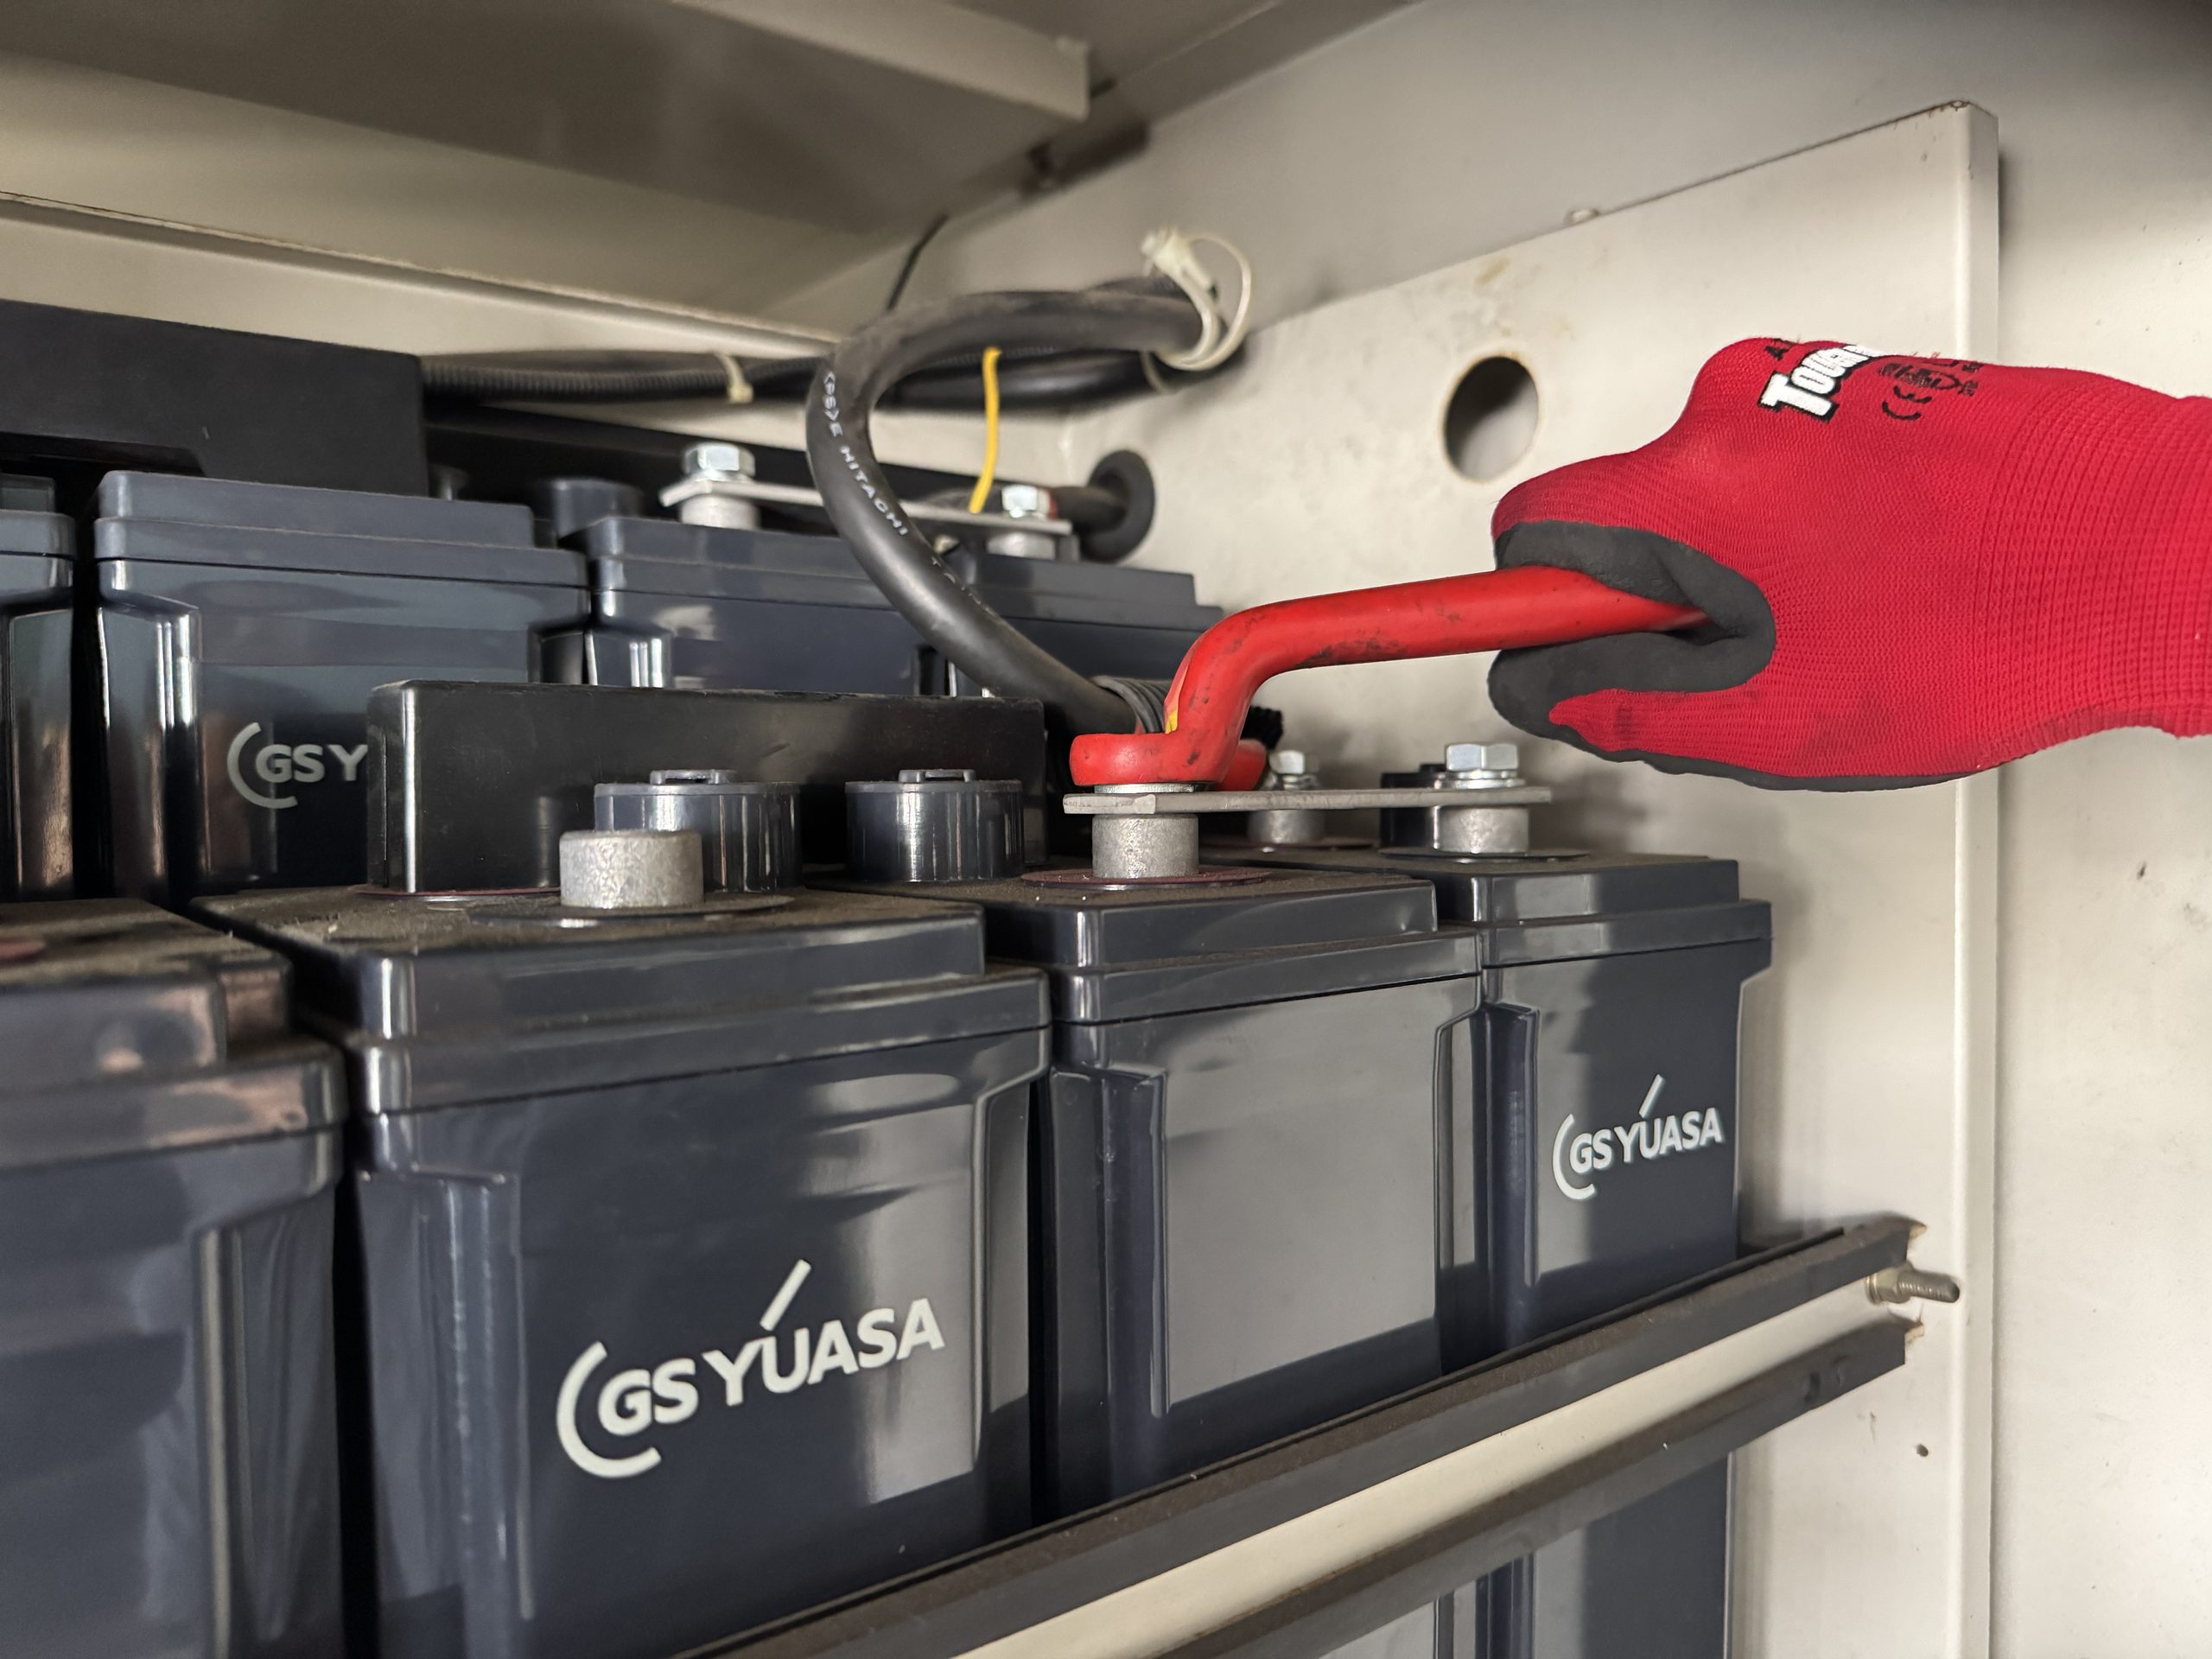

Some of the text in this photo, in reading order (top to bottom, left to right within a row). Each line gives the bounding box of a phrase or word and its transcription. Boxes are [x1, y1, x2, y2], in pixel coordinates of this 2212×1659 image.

[839, 445, 908, 535] HITACHI
[1569, 1107, 1724, 1174] GS YUASA
[597, 1298, 945, 1436] GS YUASA
